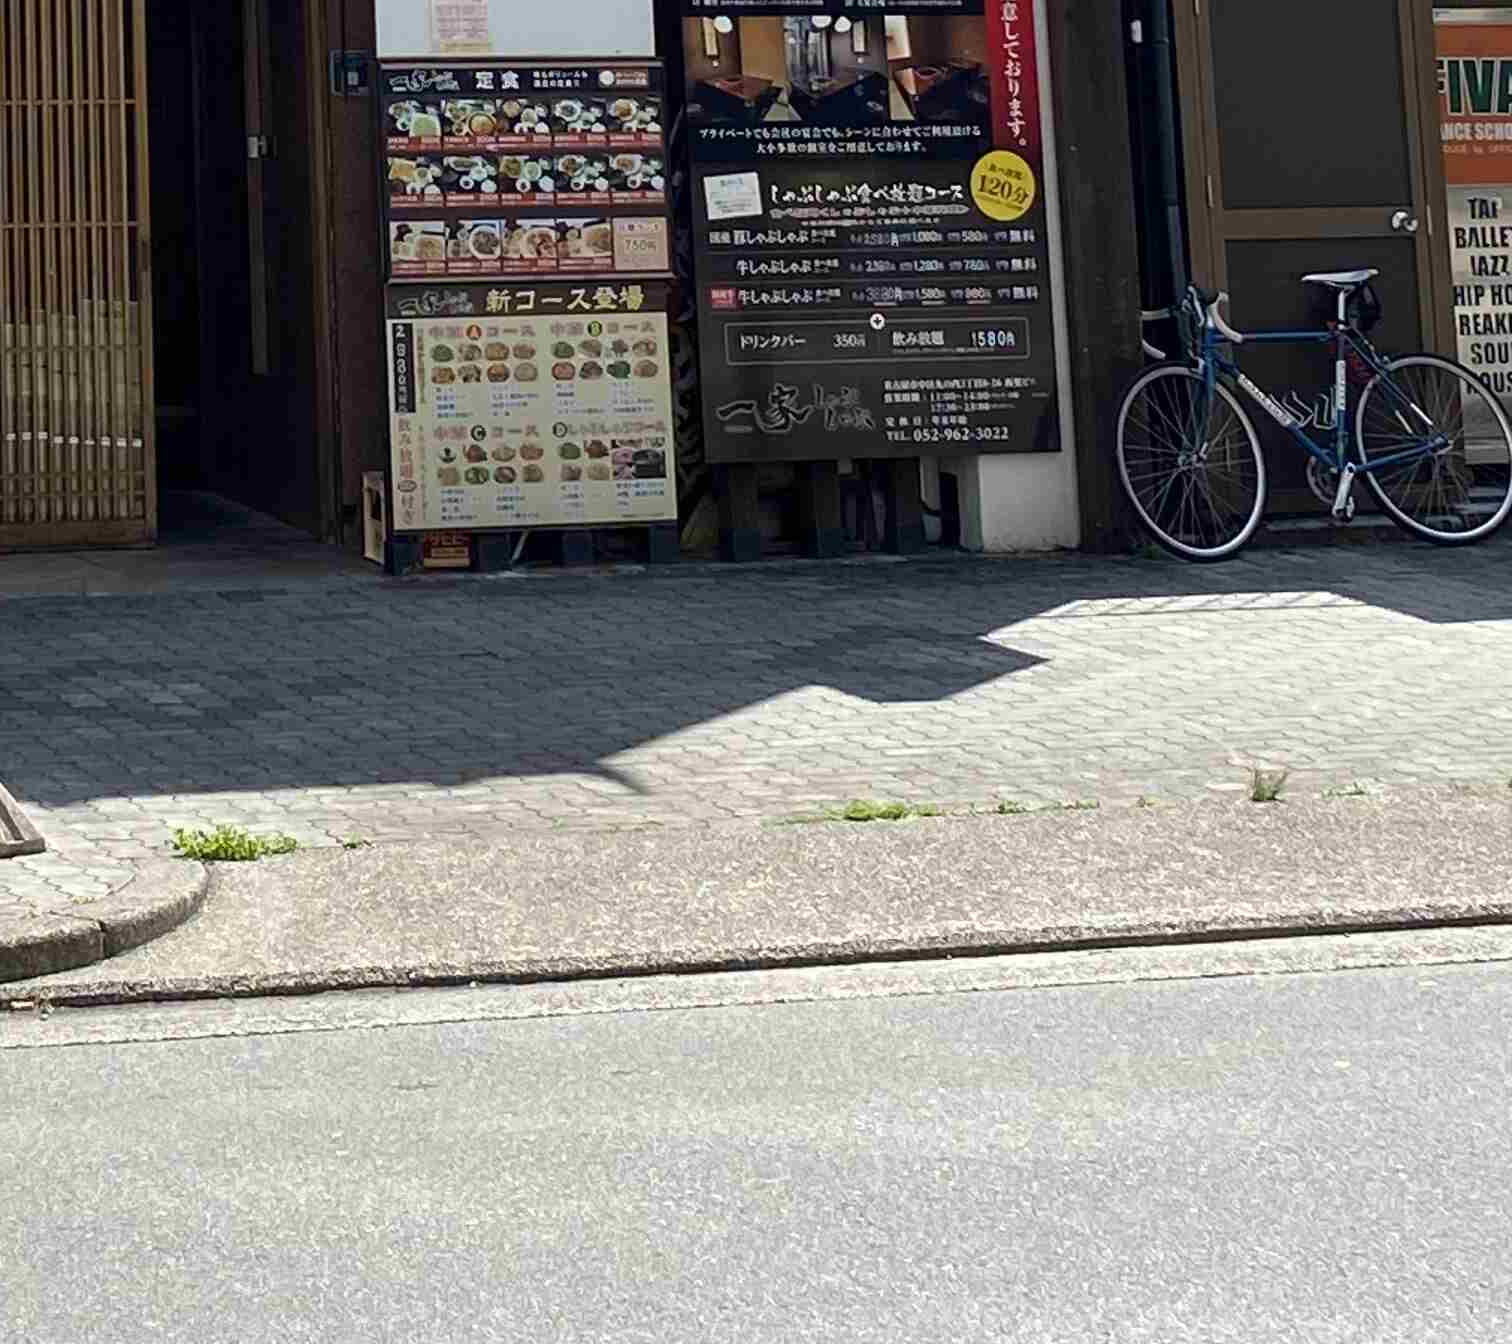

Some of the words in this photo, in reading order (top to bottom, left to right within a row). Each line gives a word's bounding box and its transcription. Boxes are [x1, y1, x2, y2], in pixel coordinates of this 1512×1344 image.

[977, 174, 1029, 205] 120分
[485, 285, 645, 311] 新コース登場
[1453, 284, 1486, 307] HIP
[740, 334, 807, 351] ドリンクバー
[913, 426, 1009, 442] 052-962-3022
